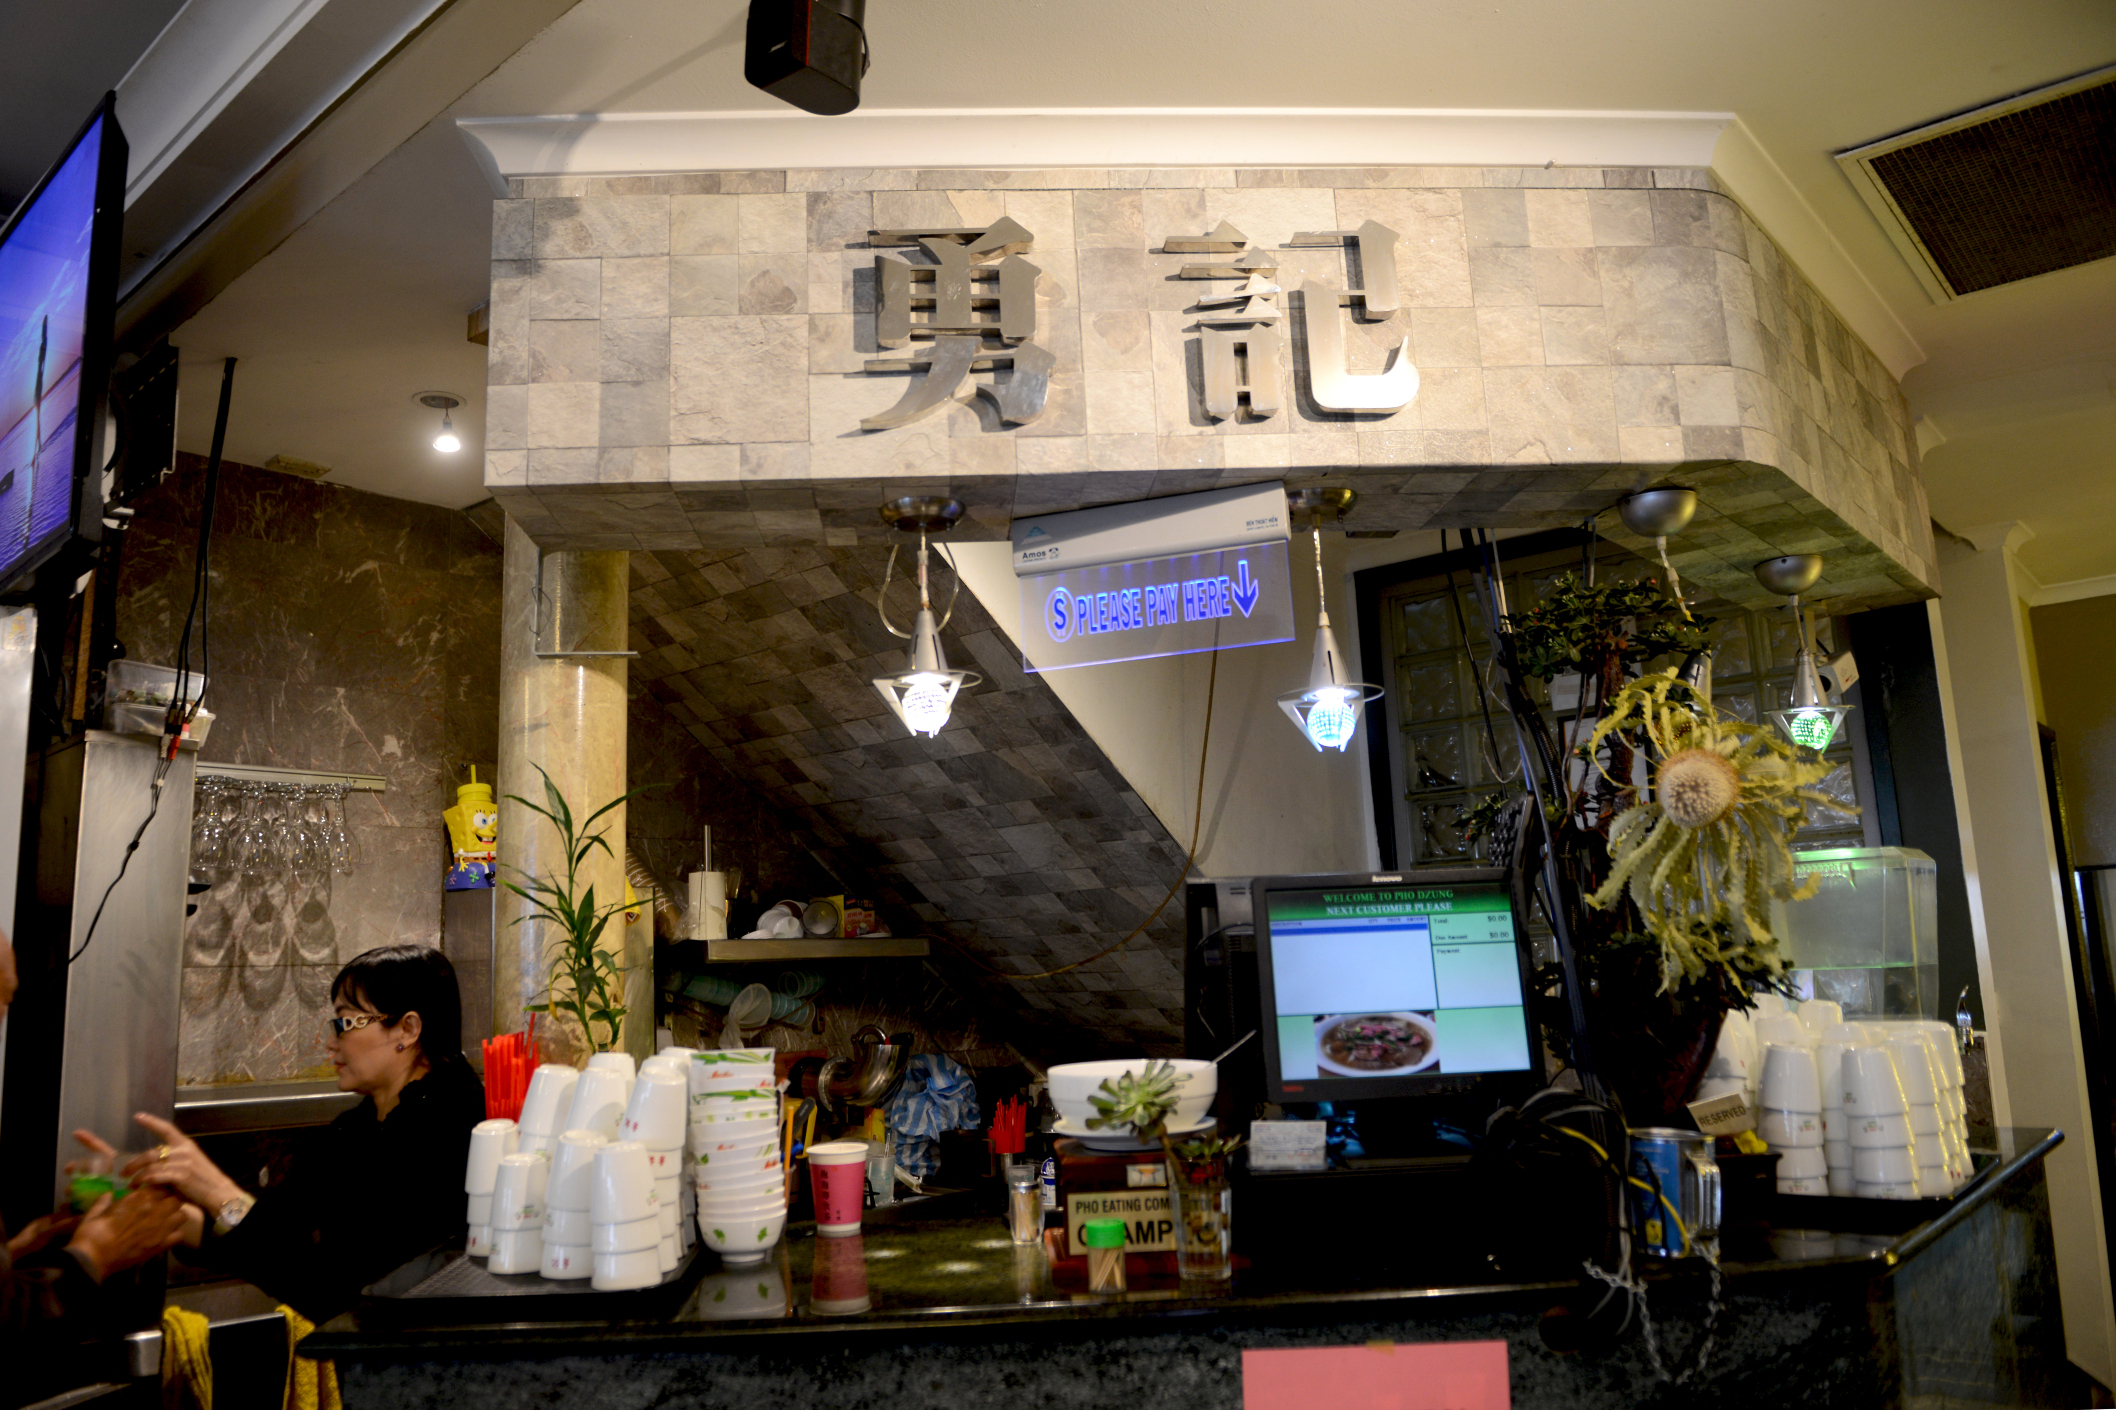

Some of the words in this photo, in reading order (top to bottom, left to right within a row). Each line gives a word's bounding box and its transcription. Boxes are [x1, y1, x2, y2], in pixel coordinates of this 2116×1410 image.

[1022, 550, 1047, 560] Amos
[1076, 587, 1144, 636] PLEASE
[1145, 582, 1179, 628] PAY
[1182, 575, 1232, 622] HERE
[1371, 875, 1403, 883] lenovo
[1323, 893, 1376, 903] WELCOME
[1378, 892, 1392, 902] TO
[1394, 891, 1415, 901] PHO
[1417, 889, 1454, 900] DZUNG
[1326, 906, 1353, 916] NEXT
[1355, 903, 1412, 915] CUSTOMER
[1414, 902, 1453, 913] PLEASE
[1489, 931, 1510, 939] $0.00
[342, 1013, 369, 1031] DG
[1698, 1105, 1747, 1128] RESERVED
[1076, 1201, 1099, 1214] PHO
[1102, 1198, 1141, 1212] EATING
